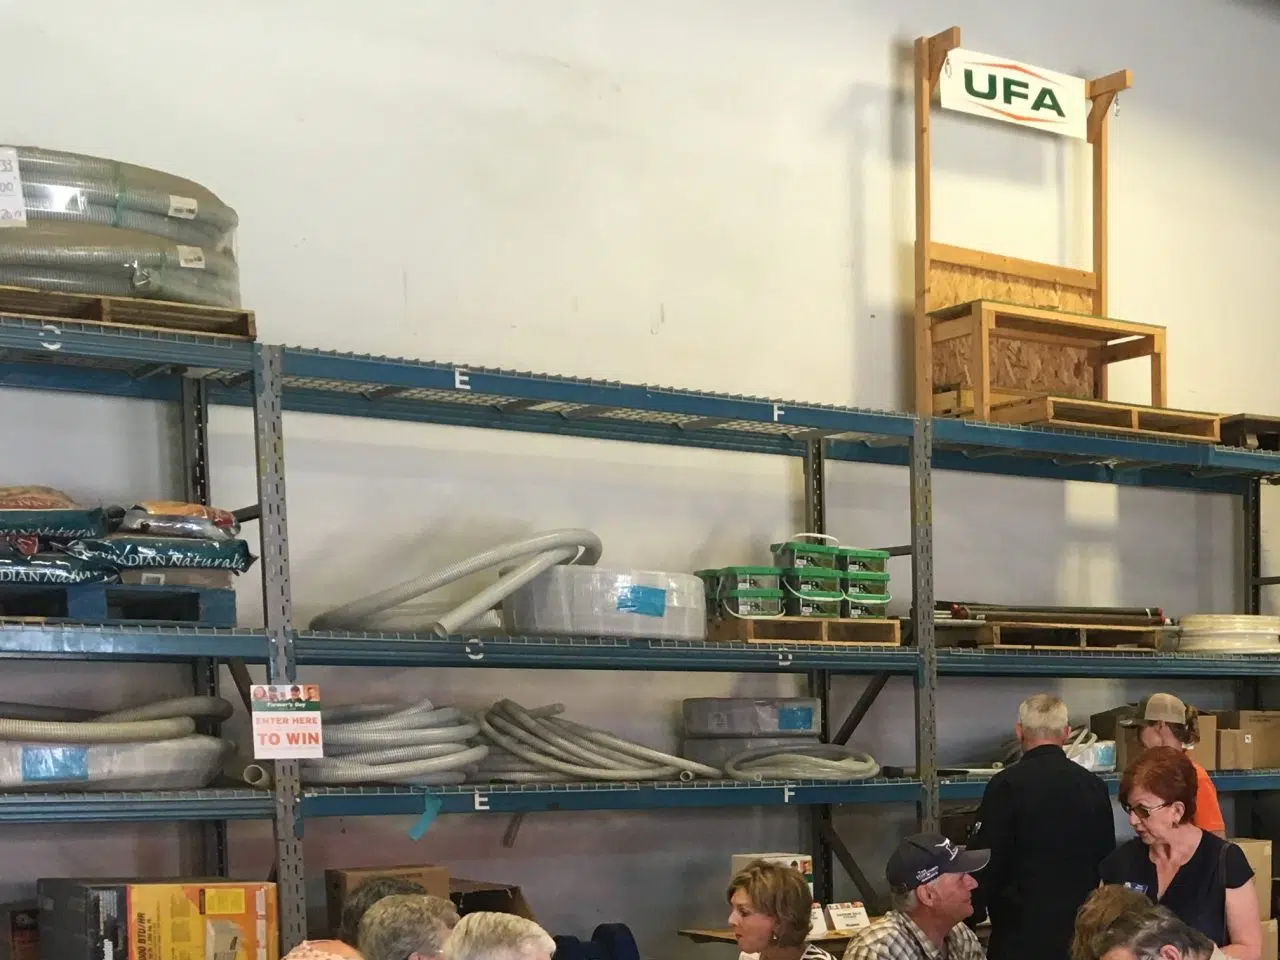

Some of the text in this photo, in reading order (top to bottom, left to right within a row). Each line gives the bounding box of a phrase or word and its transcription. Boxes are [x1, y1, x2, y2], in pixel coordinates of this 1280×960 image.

[964, 68, 1066, 118] UFA
[455, 368, 471, 389] E
[773, 404, 785, 422] F
[466, 639, 485, 660] C
[778, 648, 793, 666] D
[256, 716, 318, 725] ENTER HERE
[257, 732, 320, 746] TO WIN
[474, 790, 490, 810] E
[784, 785, 796, 802] F
